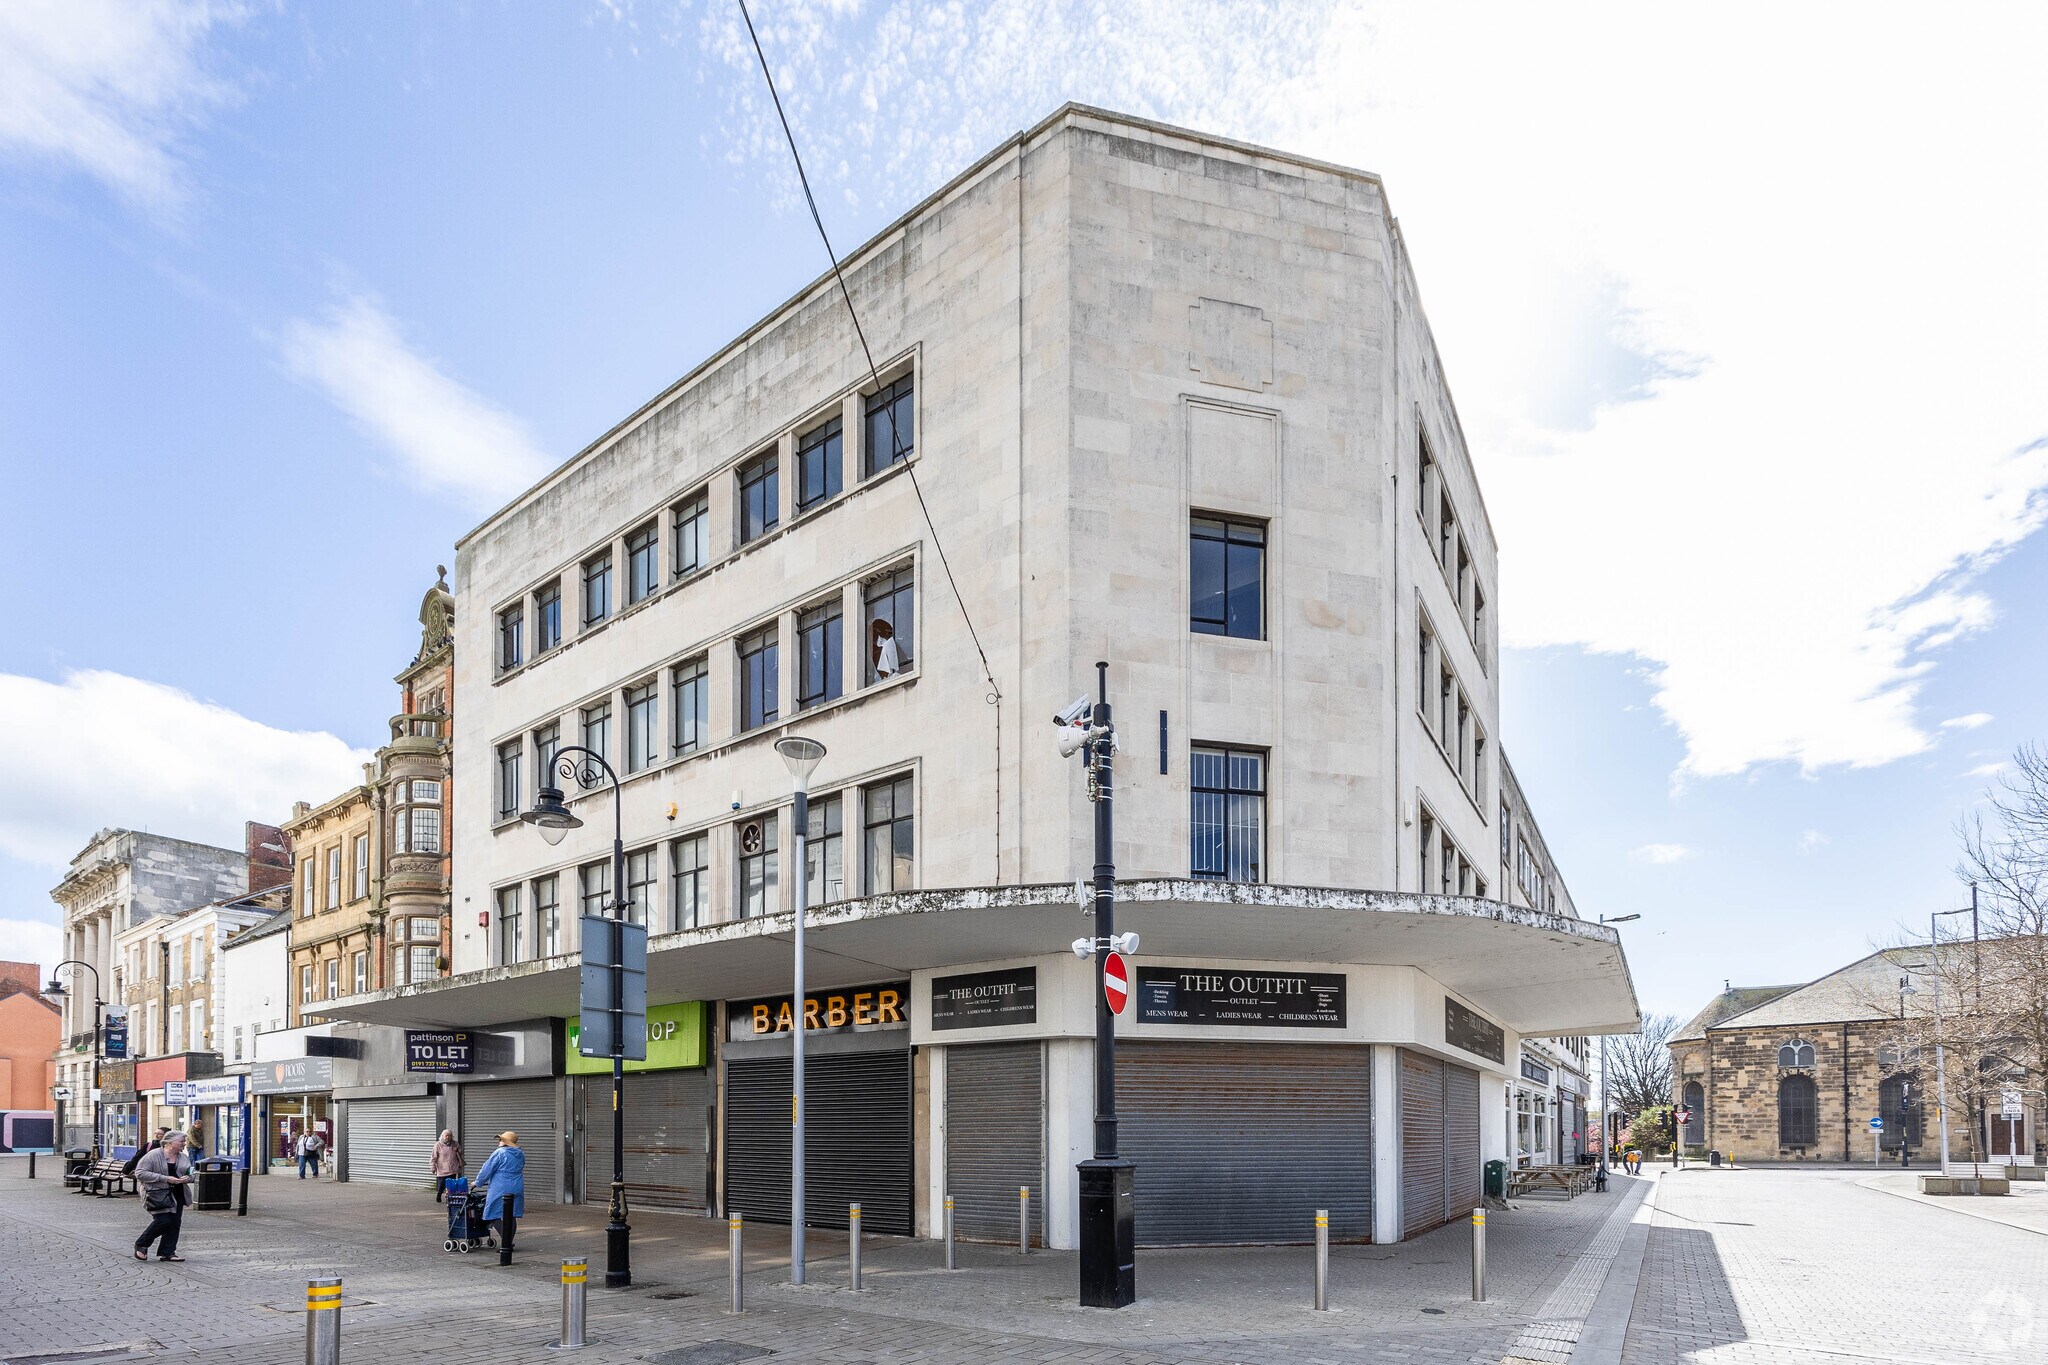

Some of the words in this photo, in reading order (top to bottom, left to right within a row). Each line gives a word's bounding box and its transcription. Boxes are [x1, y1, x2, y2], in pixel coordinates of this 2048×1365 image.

[949, 987, 972, 1000] THE
[974, 983, 1017, 997] OUTFIT
[1180, 975, 1224, 992] THE
[1229, 976, 1307, 995] OUTFIT
[1229, 997, 1259, 1005] OUTLET
[752, 990, 901, 1034] BARBER
[1167, 1010, 1189, 1018] WEAR
[1216, 1011, 1241, 1019] LADIES
[1278, 1013, 1318, 1021] CHILDRENS
[410, 1033, 454, 1043] pattinson
[411, 1045, 434, 1059] TO
[437, 1045, 469, 1059] LET
[285, 1062, 306, 1077] ROOTS
